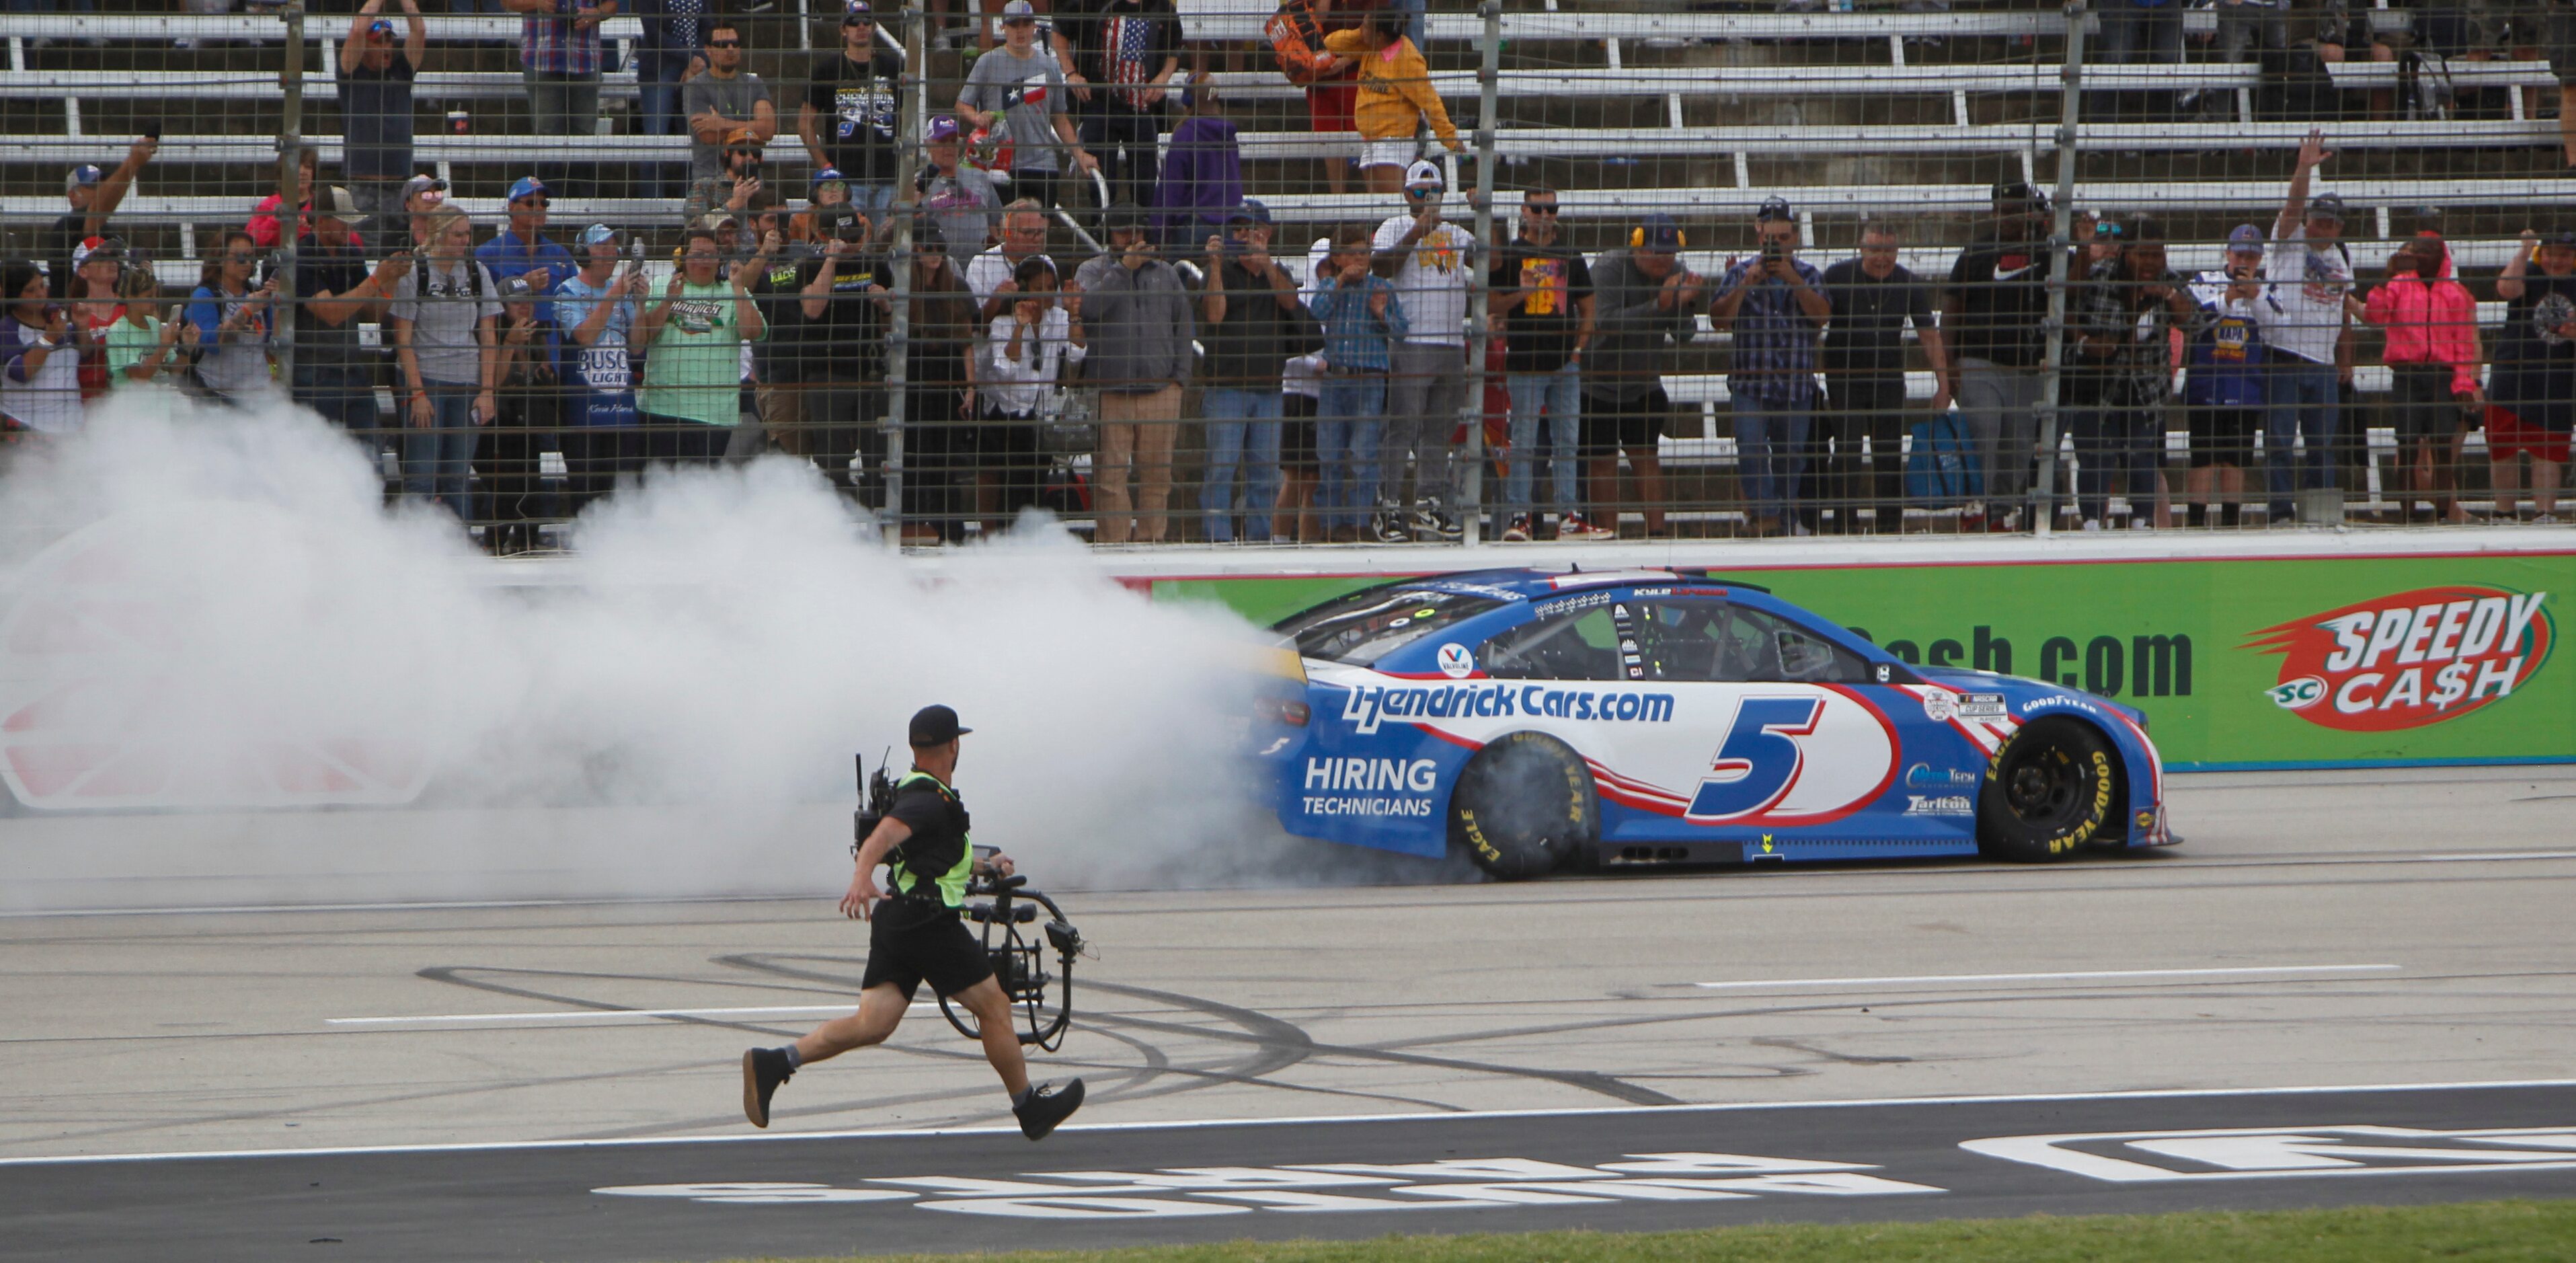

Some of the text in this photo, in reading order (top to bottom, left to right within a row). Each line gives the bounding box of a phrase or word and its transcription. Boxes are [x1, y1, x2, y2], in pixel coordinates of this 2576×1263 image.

[578, 350, 628, 371] BUSC
[1633, 588, 1671, 597] KYLE
[2316, 592, 2547, 672] SPEEDY
[2277, 656, 2524, 714] SC CA$H
[1342, 685, 1675, 734] HendrickCars.com
[1965, 704, 2000, 712] CUP SERIES
[2023, 695, 2097, 714] GOODYEAR
[1684, 695, 1826, 823] 5
[1304, 757, 1437, 792] HIRING
[1303, 797, 1432, 816] TECHNICIANS
[1908, 795, 1971, 812] Tarlton
[1460, 809, 1501, 862] EAGLE
